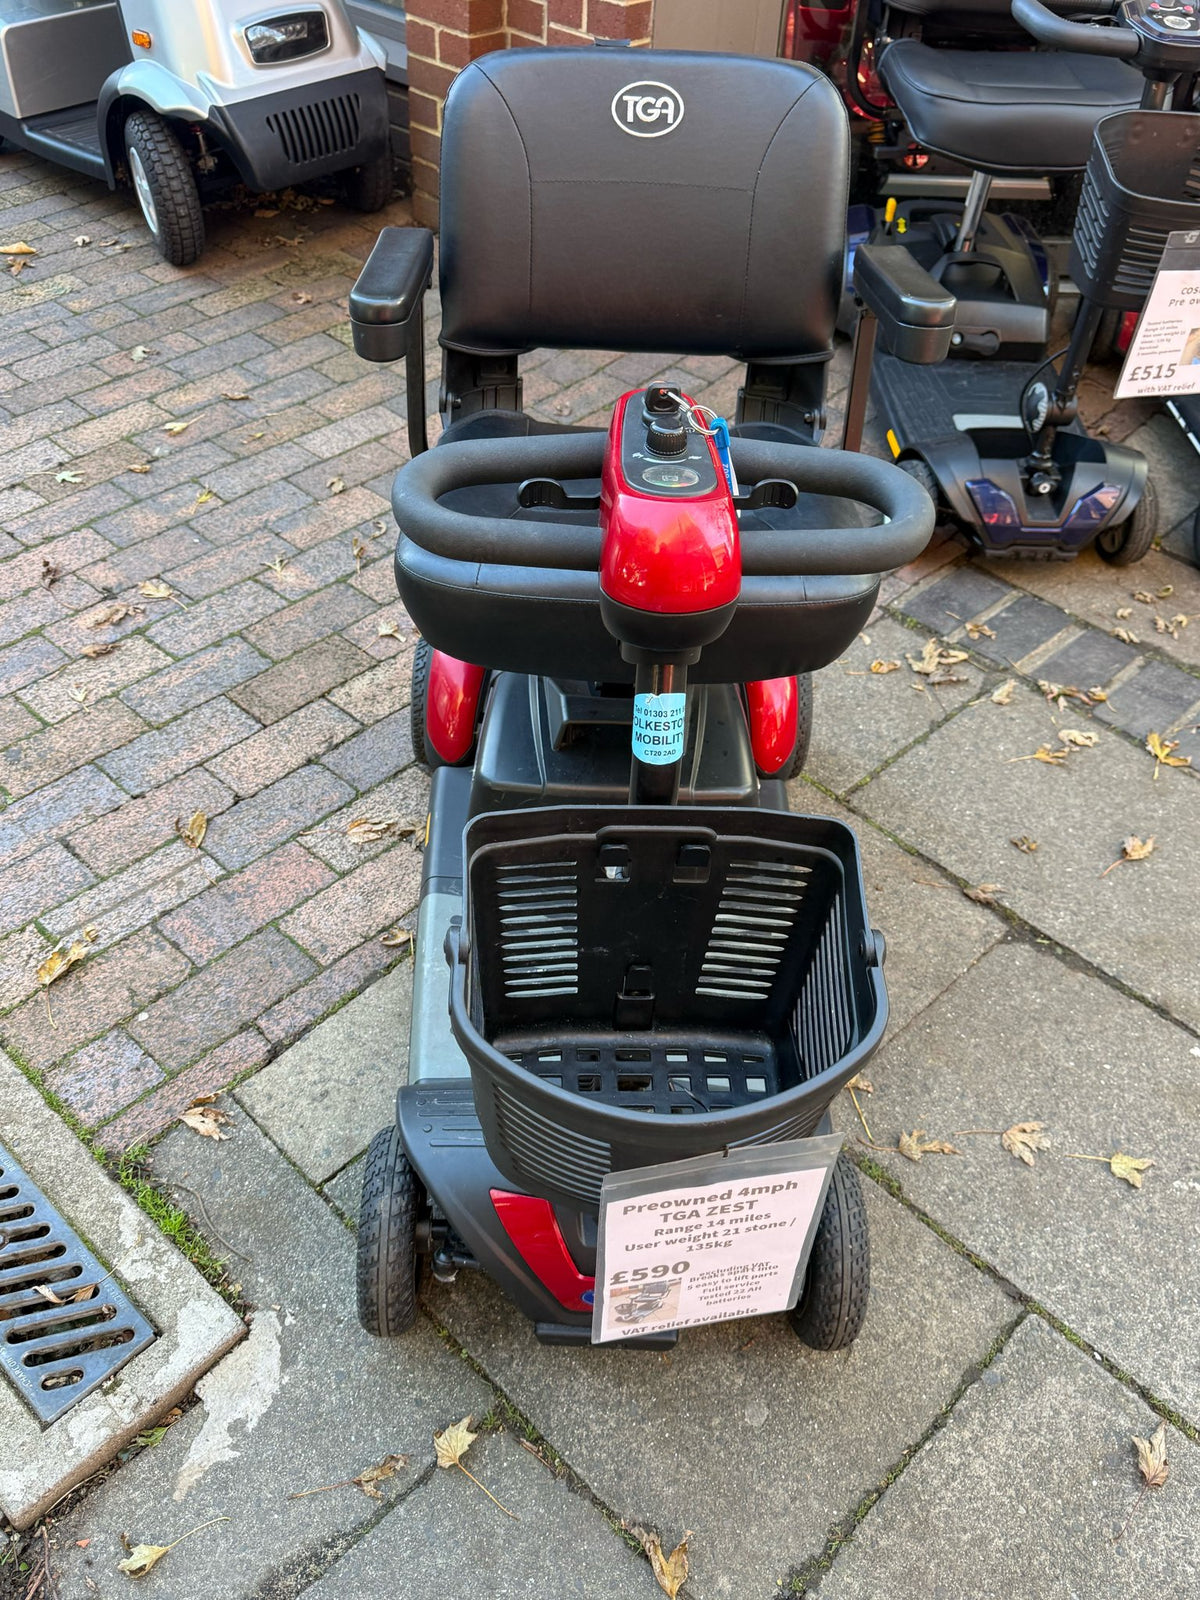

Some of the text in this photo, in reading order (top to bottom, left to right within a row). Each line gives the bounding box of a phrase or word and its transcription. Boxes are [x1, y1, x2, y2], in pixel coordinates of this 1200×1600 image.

[622, 95, 675, 124] TGA
[1181, 286, 1200, 295] COS
[1168, 298, 1186, 307] Pre
[1128, 363, 1177, 382] £515
[1137, 385, 1156, 394] with
[1157, 384, 1172, 392] VAT
[643, 708, 668, 718] 01303
[633, 715, 684, 731] OLKESTO
[643, 748, 676, 757] CT20 2AD
[622, 1181, 798, 1215] Preowned 4mph
[659, 1200, 759, 1223] TGA ZEST
[654, 1212, 772, 1237] Range 14 miles
[624, 1240, 661, 1252] User
[664, 1231, 719, 1245] weight
[723, 1228, 740, 1237] 21
[744, 1221, 787, 1233] stone
[686, 1240, 733, 1252] 135kg
[610, 1260, 691, 1286] £590
[689, 1272, 724, 1283] Breaks
[757, 1264, 779, 1272] into
[699, 1261, 771, 1277] excluding VAT
[695, 1280, 719, 1289] easy
[751, 1271, 779, 1280] parts
[702, 1280, 761, 1294] Full service
[698, 1290, 732, 1302] Tested
[747, 1285, 762, 1293] AH
[705, 1294, 752, 1306] batteries
[621, 1307, 759, 1336] VAT relief available
